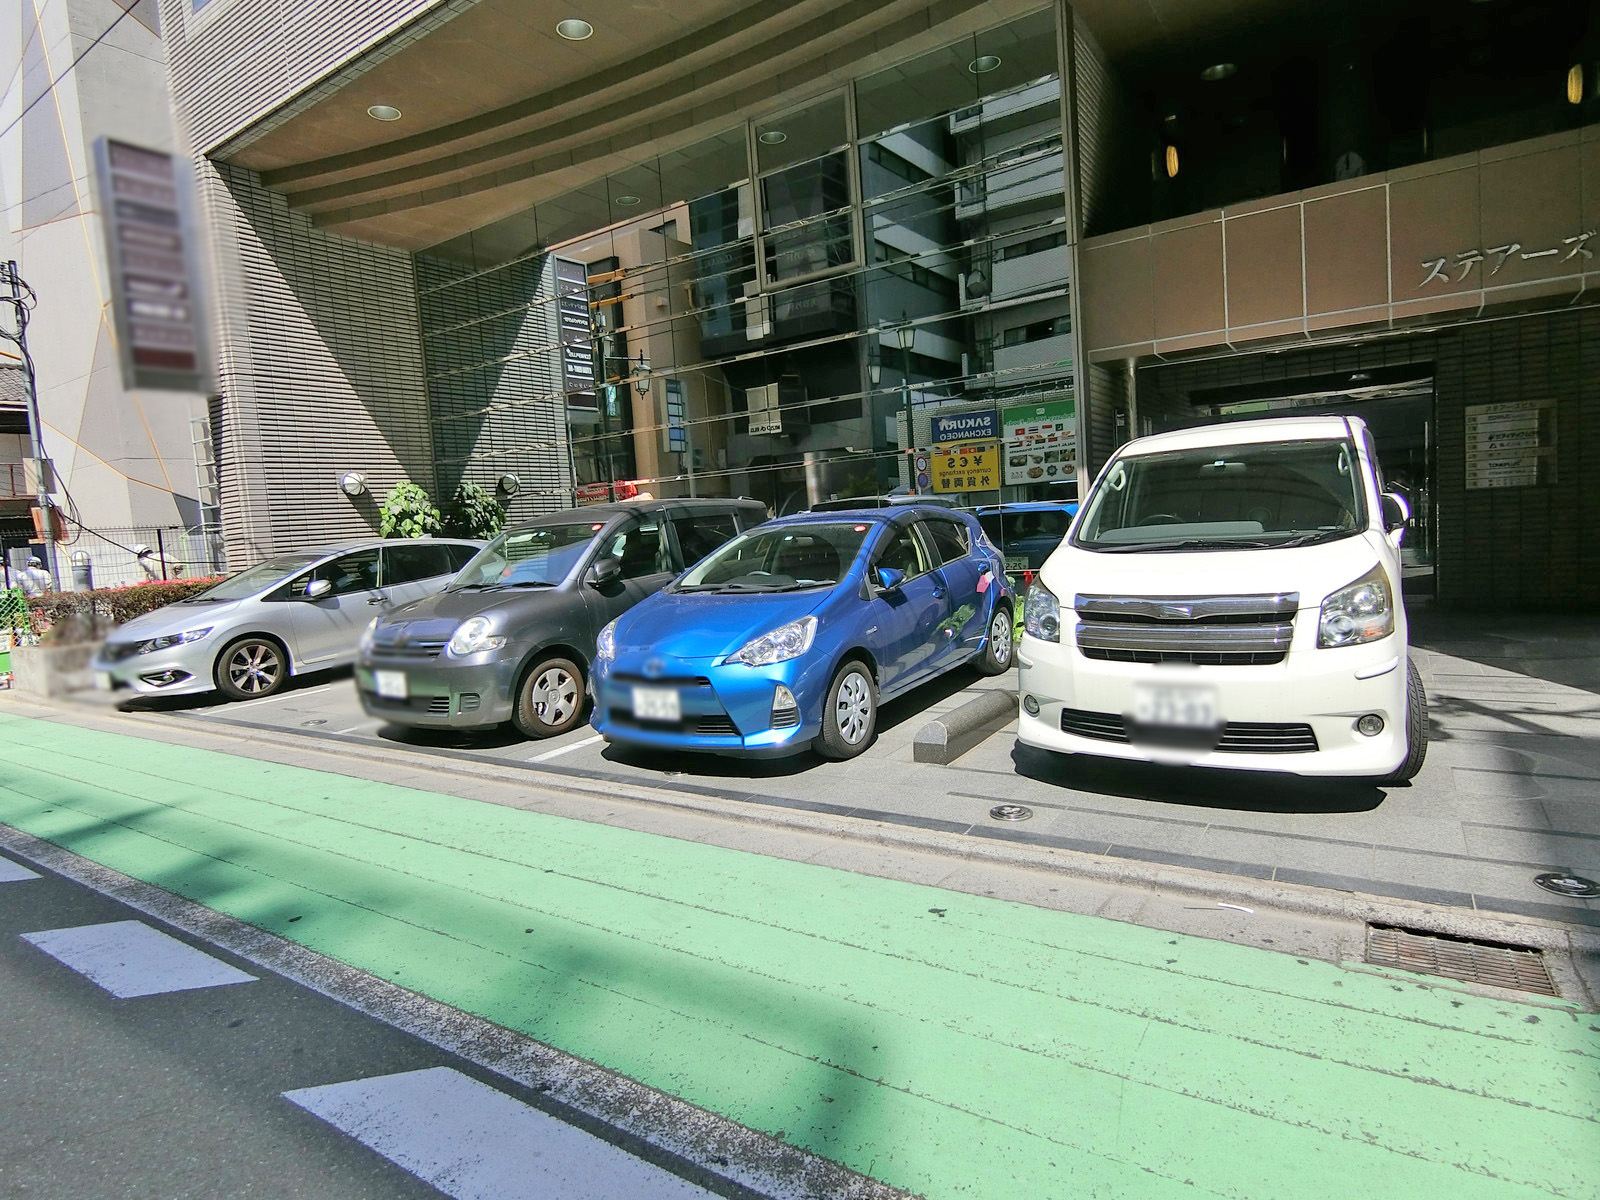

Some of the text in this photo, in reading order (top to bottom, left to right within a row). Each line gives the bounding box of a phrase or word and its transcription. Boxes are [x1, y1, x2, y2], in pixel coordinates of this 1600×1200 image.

[1418, 229, 1597, 288] ステアーズ
